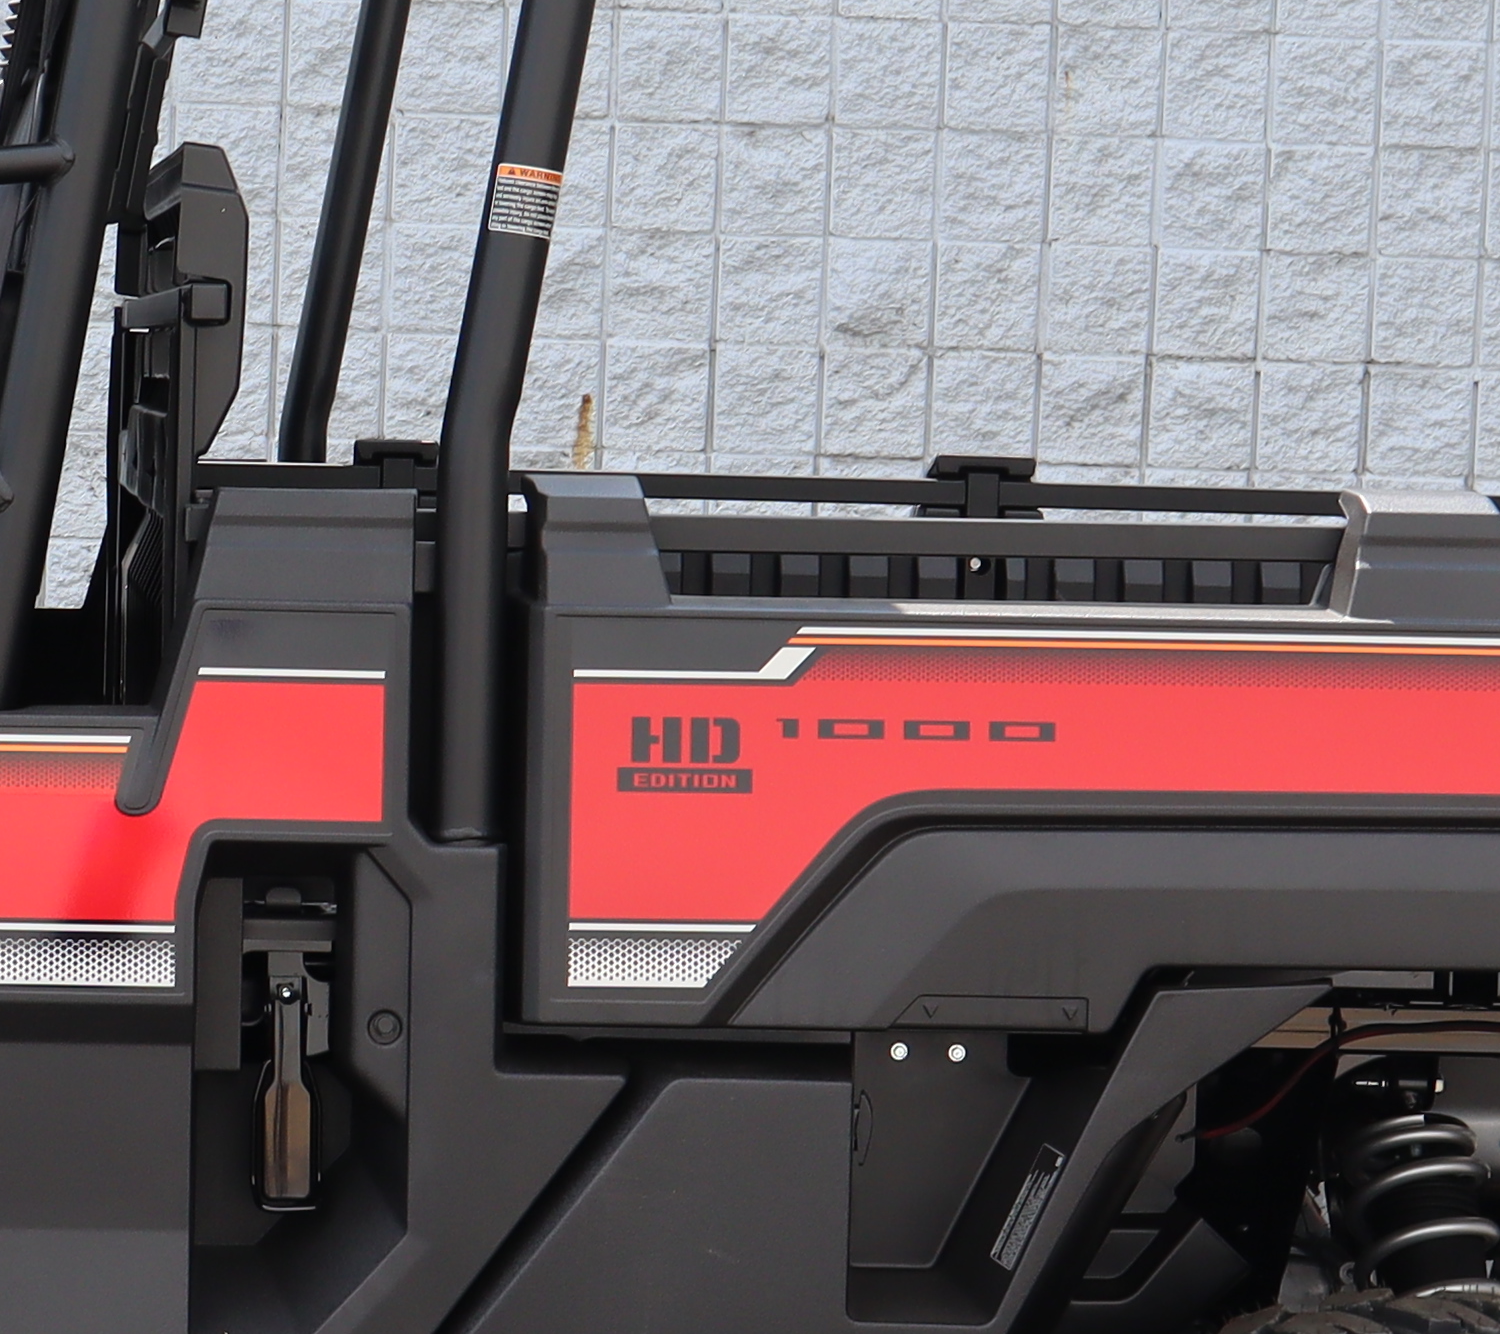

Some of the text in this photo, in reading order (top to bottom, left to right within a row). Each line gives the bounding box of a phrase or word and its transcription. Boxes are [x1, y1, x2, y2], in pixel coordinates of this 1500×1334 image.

[630, 716, 1056, 764] HD 1000
[632, 772, 738, 790] EDITION
